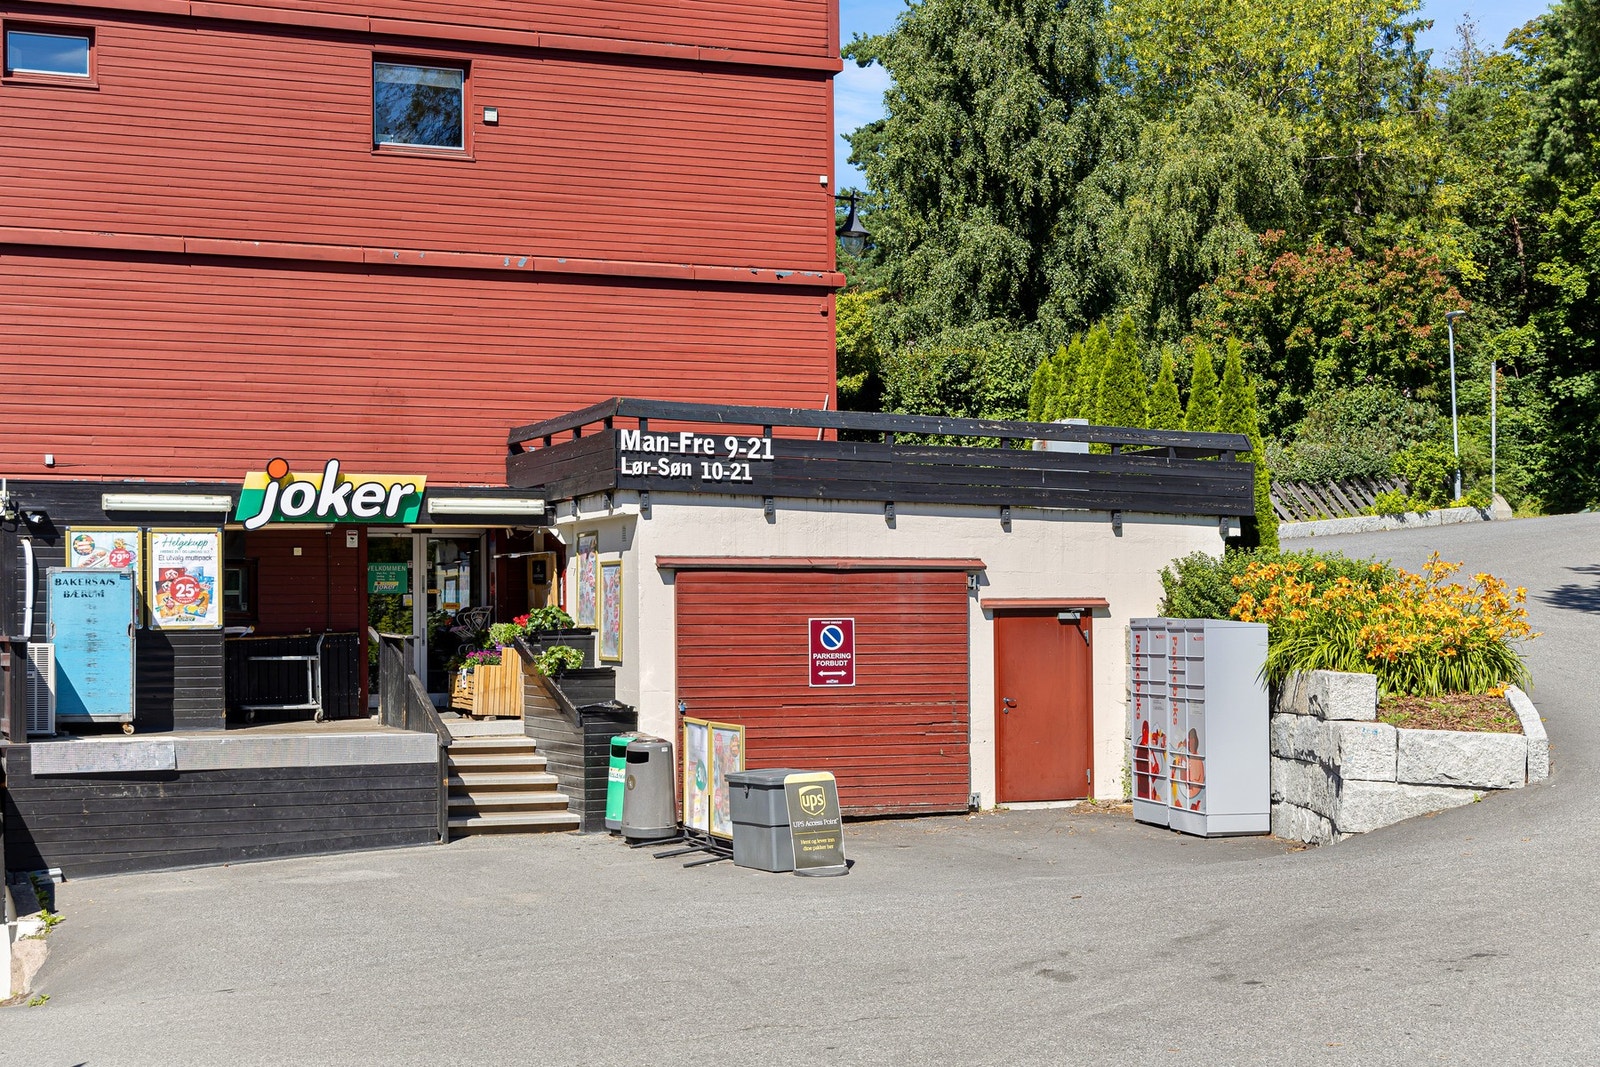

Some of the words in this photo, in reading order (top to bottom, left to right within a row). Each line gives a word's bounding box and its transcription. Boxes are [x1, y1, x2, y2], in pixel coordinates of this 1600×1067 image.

[620, 429, 715, 455] Man-Fre
[724, 436, 775, 460] 9-21
[621, 456, 692, 477] Lør-Søn
[701, 461, 753, 481] 10-21
[244, 457, 416, 531] joker
[162, 536, 209, 550] Helgekupp
[166, 554, 184, 562] utvalg
[185, 554, 212, 562] multipack
[176, 583, 195, 598] 25
[802, 794, 824, 811] ups
